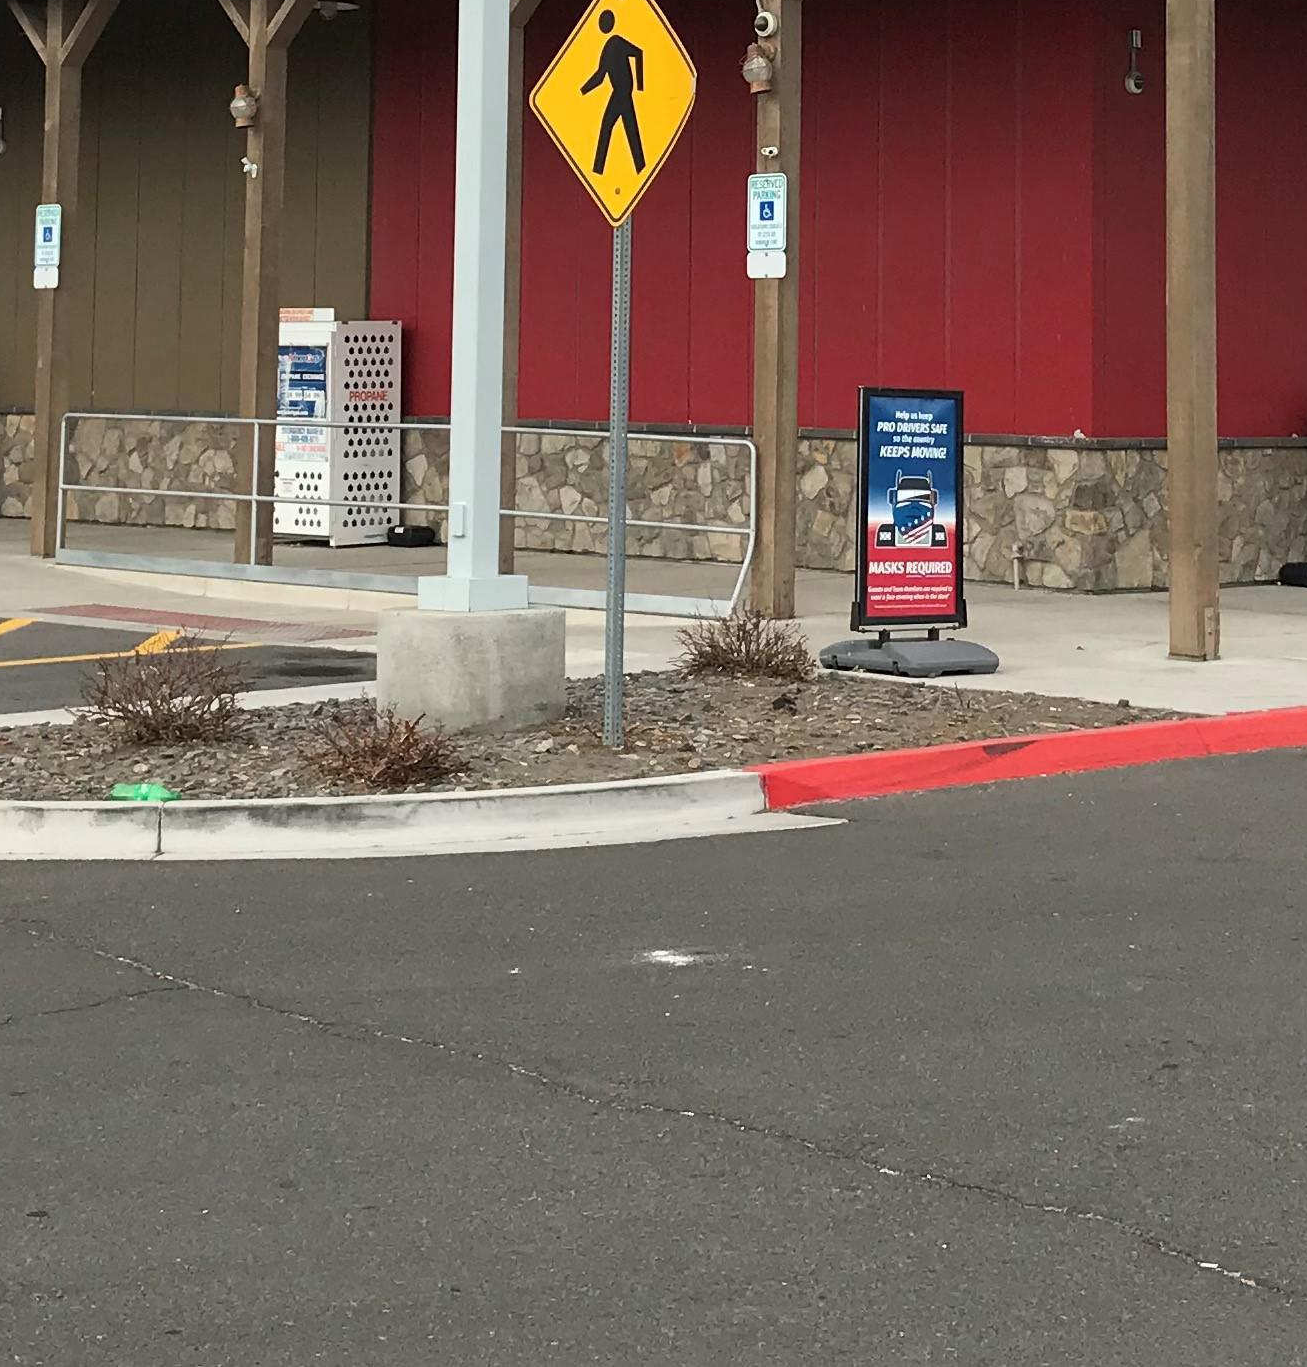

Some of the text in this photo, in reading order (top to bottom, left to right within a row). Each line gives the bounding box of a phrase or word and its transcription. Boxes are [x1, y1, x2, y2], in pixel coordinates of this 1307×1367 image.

[753, 190, 781, 200] PARKING
[349, 391, 388, 402] PROPANE
[895, 410, 909, 421] Help
[877, 421, 948, 435] PRO DRIVERS SAFE
[880, 445, 947, 459] KEEPS MOVING!
[868, 561, 953, 575] MASKS REQUIRED
